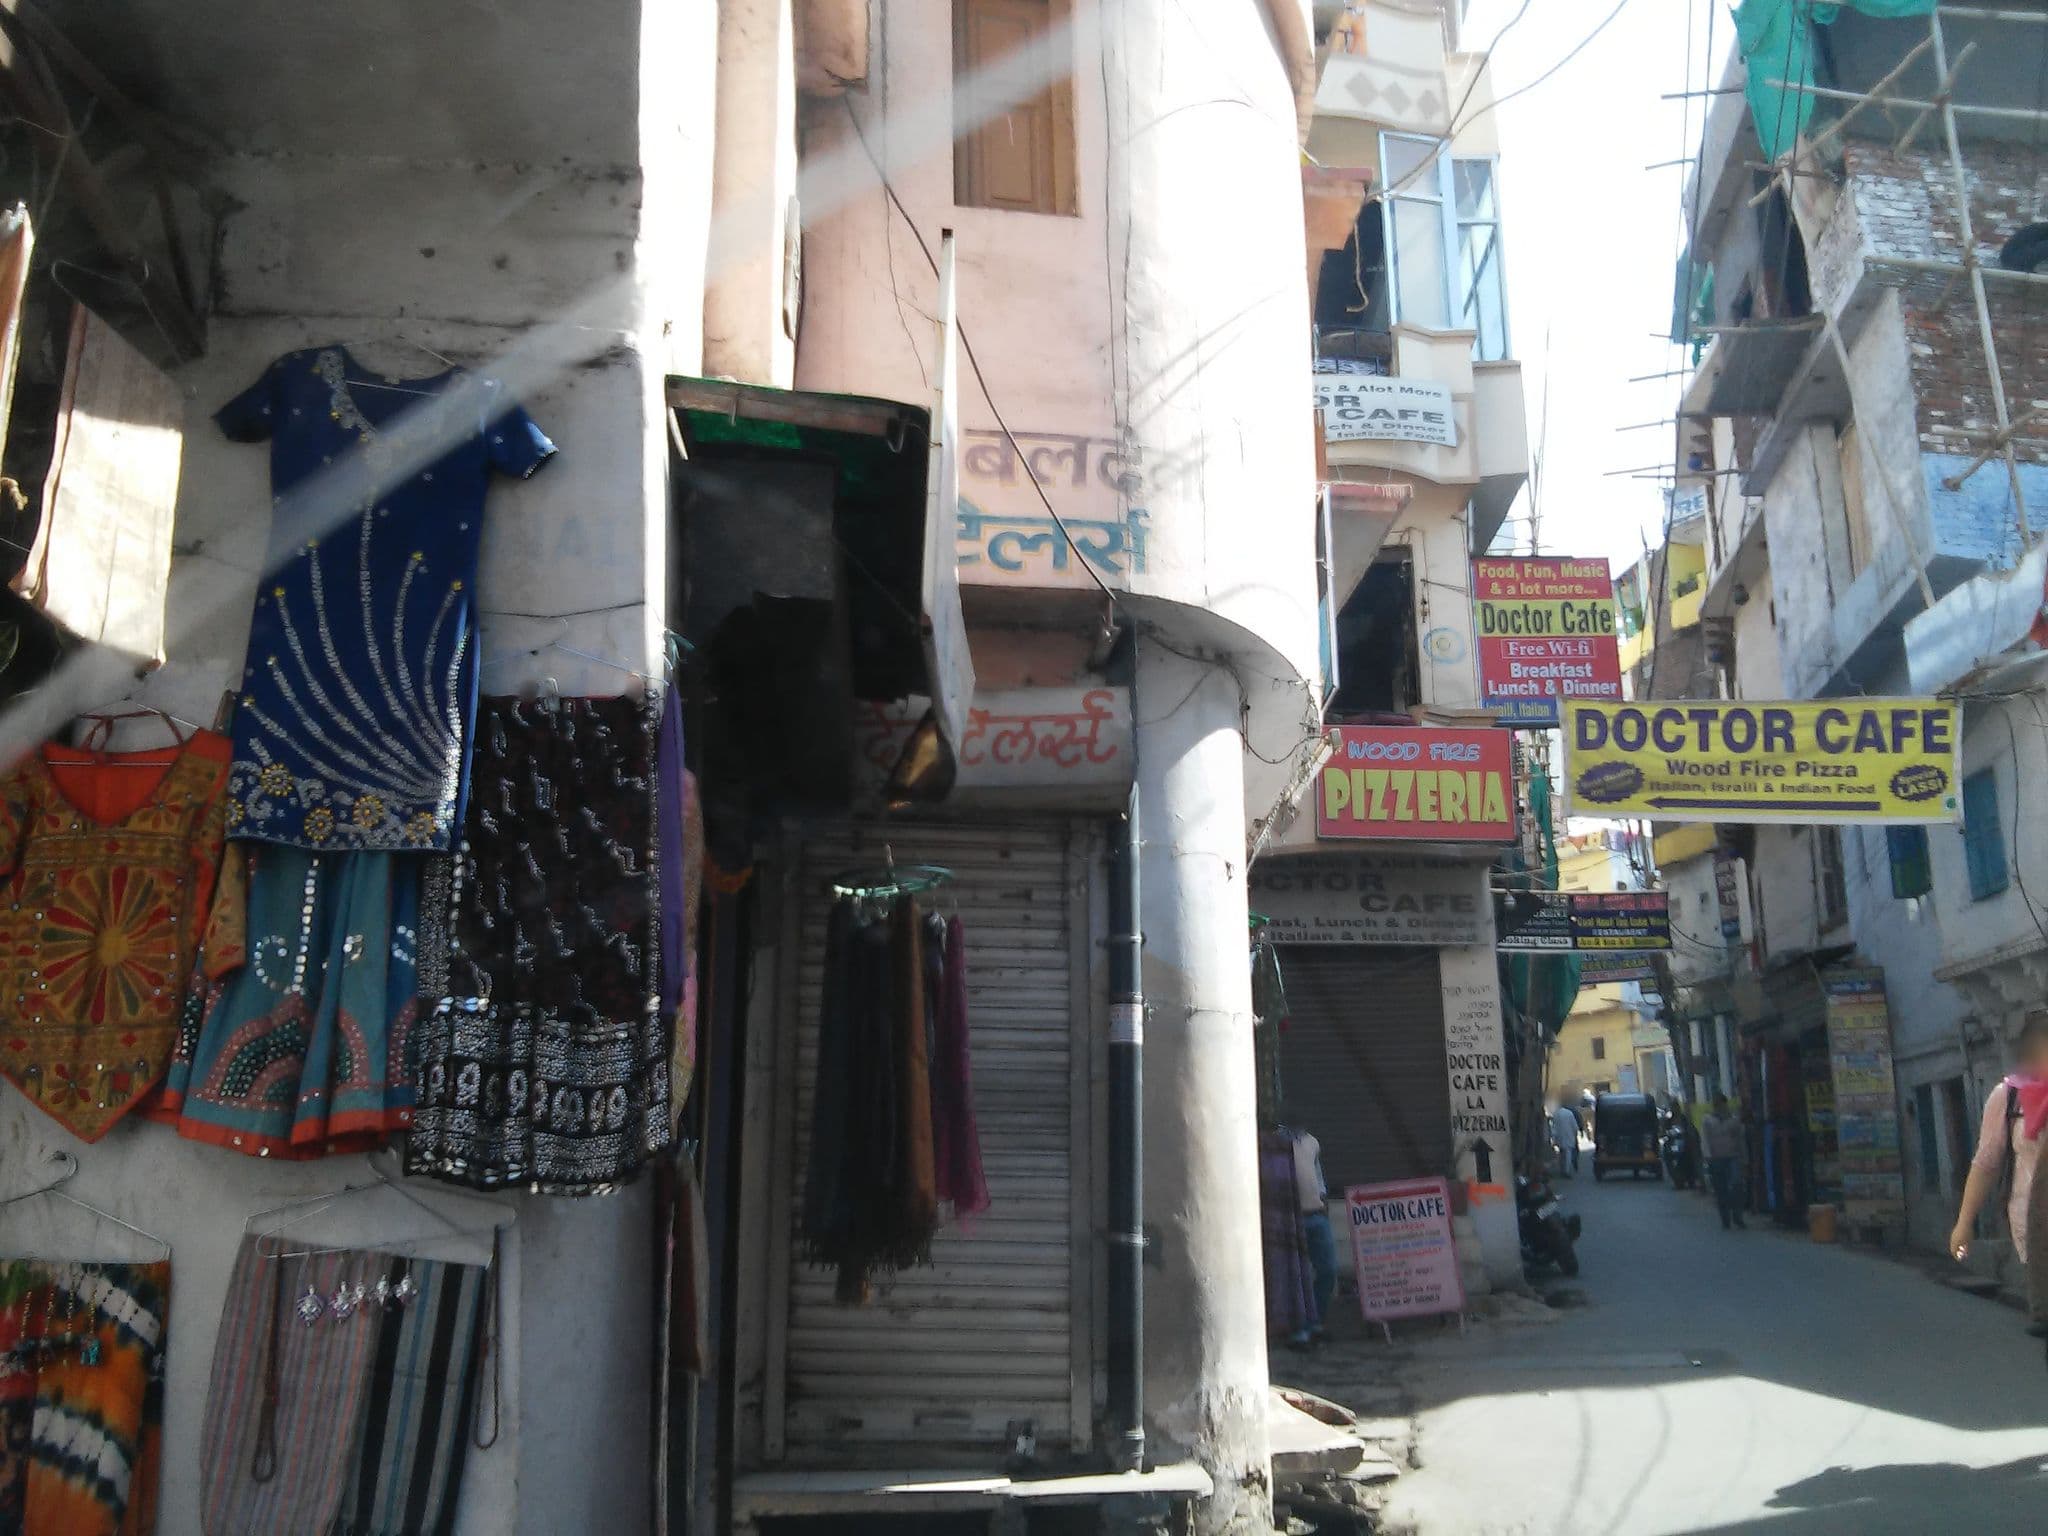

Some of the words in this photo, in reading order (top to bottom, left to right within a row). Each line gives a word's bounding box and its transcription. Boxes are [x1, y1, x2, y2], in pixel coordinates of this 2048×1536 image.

[1358, 385, 1393, 393] Alot
[1336, 408, 1445, 424] CAFE
[1478, 562, 1520, 581] Food,
[1524, 562, 1557, 581] Fun,
[1561, 562, 1605, 578] Music
[1490, 582, 1501, 595] &
[1506, 585, 1516, 595] a
[1520, 582, 1541, 595] lot
[1481, 602, 1552, 634] Doctor
[1561, 601, 1612, 634] Cafe
[1508, 641, 1545, 656] Free
[1548, 640, 1590, 656] Wi-fi
[1510, 662, 1593, 678] Breakfast
[1488, 680, 1539, 695] Lunch
[1545, 679, 1555, 695] &
[1562, 679, 1617, 696] Dinner
[1575, 708, 1795, 754] DOCTOR
[1816, 708, 1952, 754] CAFE
[1348, 740, 1420, 761] WOOD
[1666, 759, 1730, 777] Wood
[1741, 760, 1786, 777] Fire
[1796, 761, 1859, 778] Pizza
[1324, 768, 1509, 824] PIZZERIA
[1764, 783, 1774, 793] &
[1782, 783, 1832, 793] Indian
[1838, 783, 1876, 794] Food
[1248, 872, 1385, 891] CTOR
[1359, 894, 1478, 913] CAFE
[1314, 916, 1377, 928] Lunch
[1385, 918, 1400, 928] &
[1449, 1054, 1501, 1070] DOCTOR
[1452, 1074, 1498, 1091] CAFE
[1467, 1096, 1486, 1110] LA
[1452, 1115, 1507, 1132] PIZZERIA
[1352, 1201, 1406, 1226] DOCTOR
[1408, 1197, 1446, 1220] CAFE
